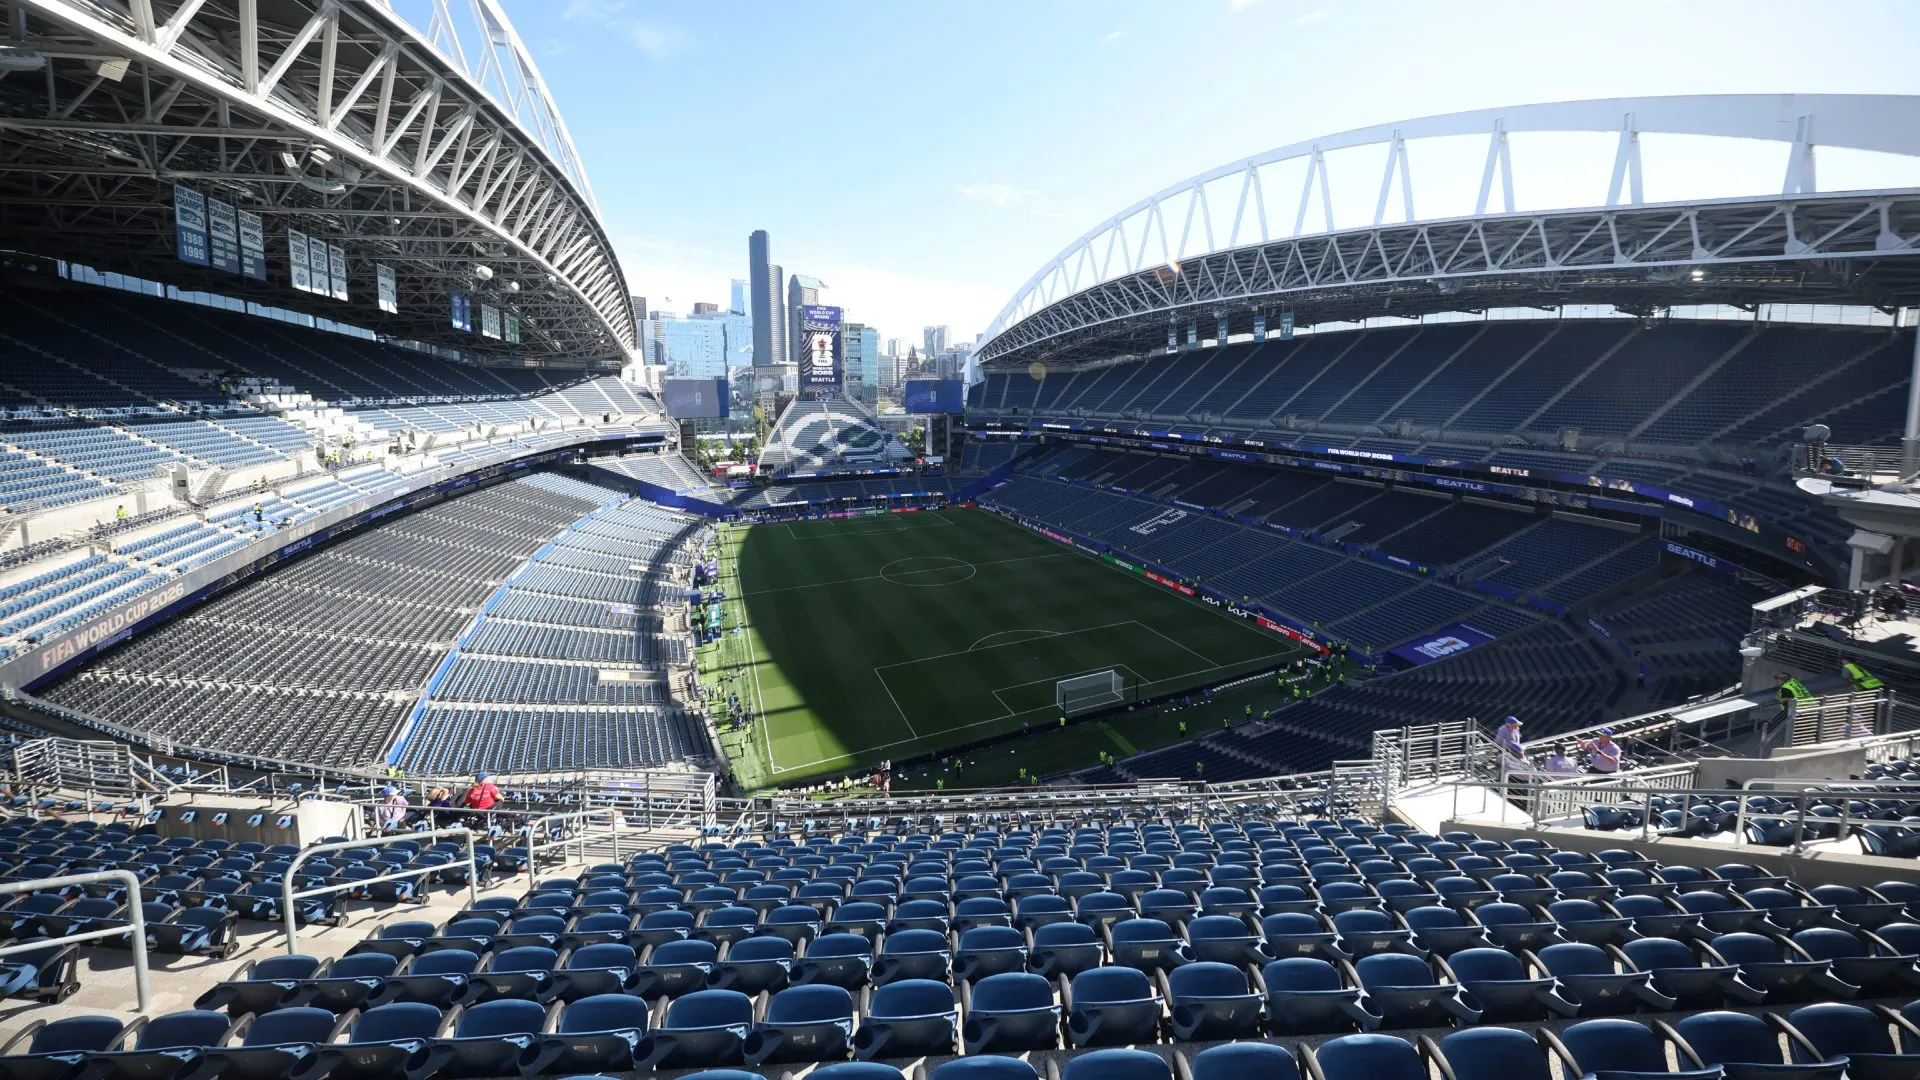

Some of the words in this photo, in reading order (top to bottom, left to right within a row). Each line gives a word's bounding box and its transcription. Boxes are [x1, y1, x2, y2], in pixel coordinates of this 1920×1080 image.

[188, 191, 204, 203] WEST
[175, 195, 204, 213] CHAMPS
[182, 231, 204, 246] 1988
[183, 244, 205, 259] 1999
[1254, 326, 1264, 336] 96
[1282, 323, 1291, 333] 71
[1219, 330, 1227, 340] 12
[1220, 452, 1247, 460] SEATTLE
[1340, 449, 1359, 457] WORLD
[1371, 452, 1393, 461] 2026
[1490, 466, 1530, 477] SEATTLE
[1436, 478, 1485, 491] SEATTLE
[284, 537, 312, 555] SEATTLE
[1666, 543, 1717, 568] SEATTLE
[40, 639, 75, 670] FIFA
[75, 614, 125, 650] WORLD
[124, 602, 151, 624] CUP
[149, 582, 185, 609] 2026
[1266, 622, 1290, 636] Lenovo
